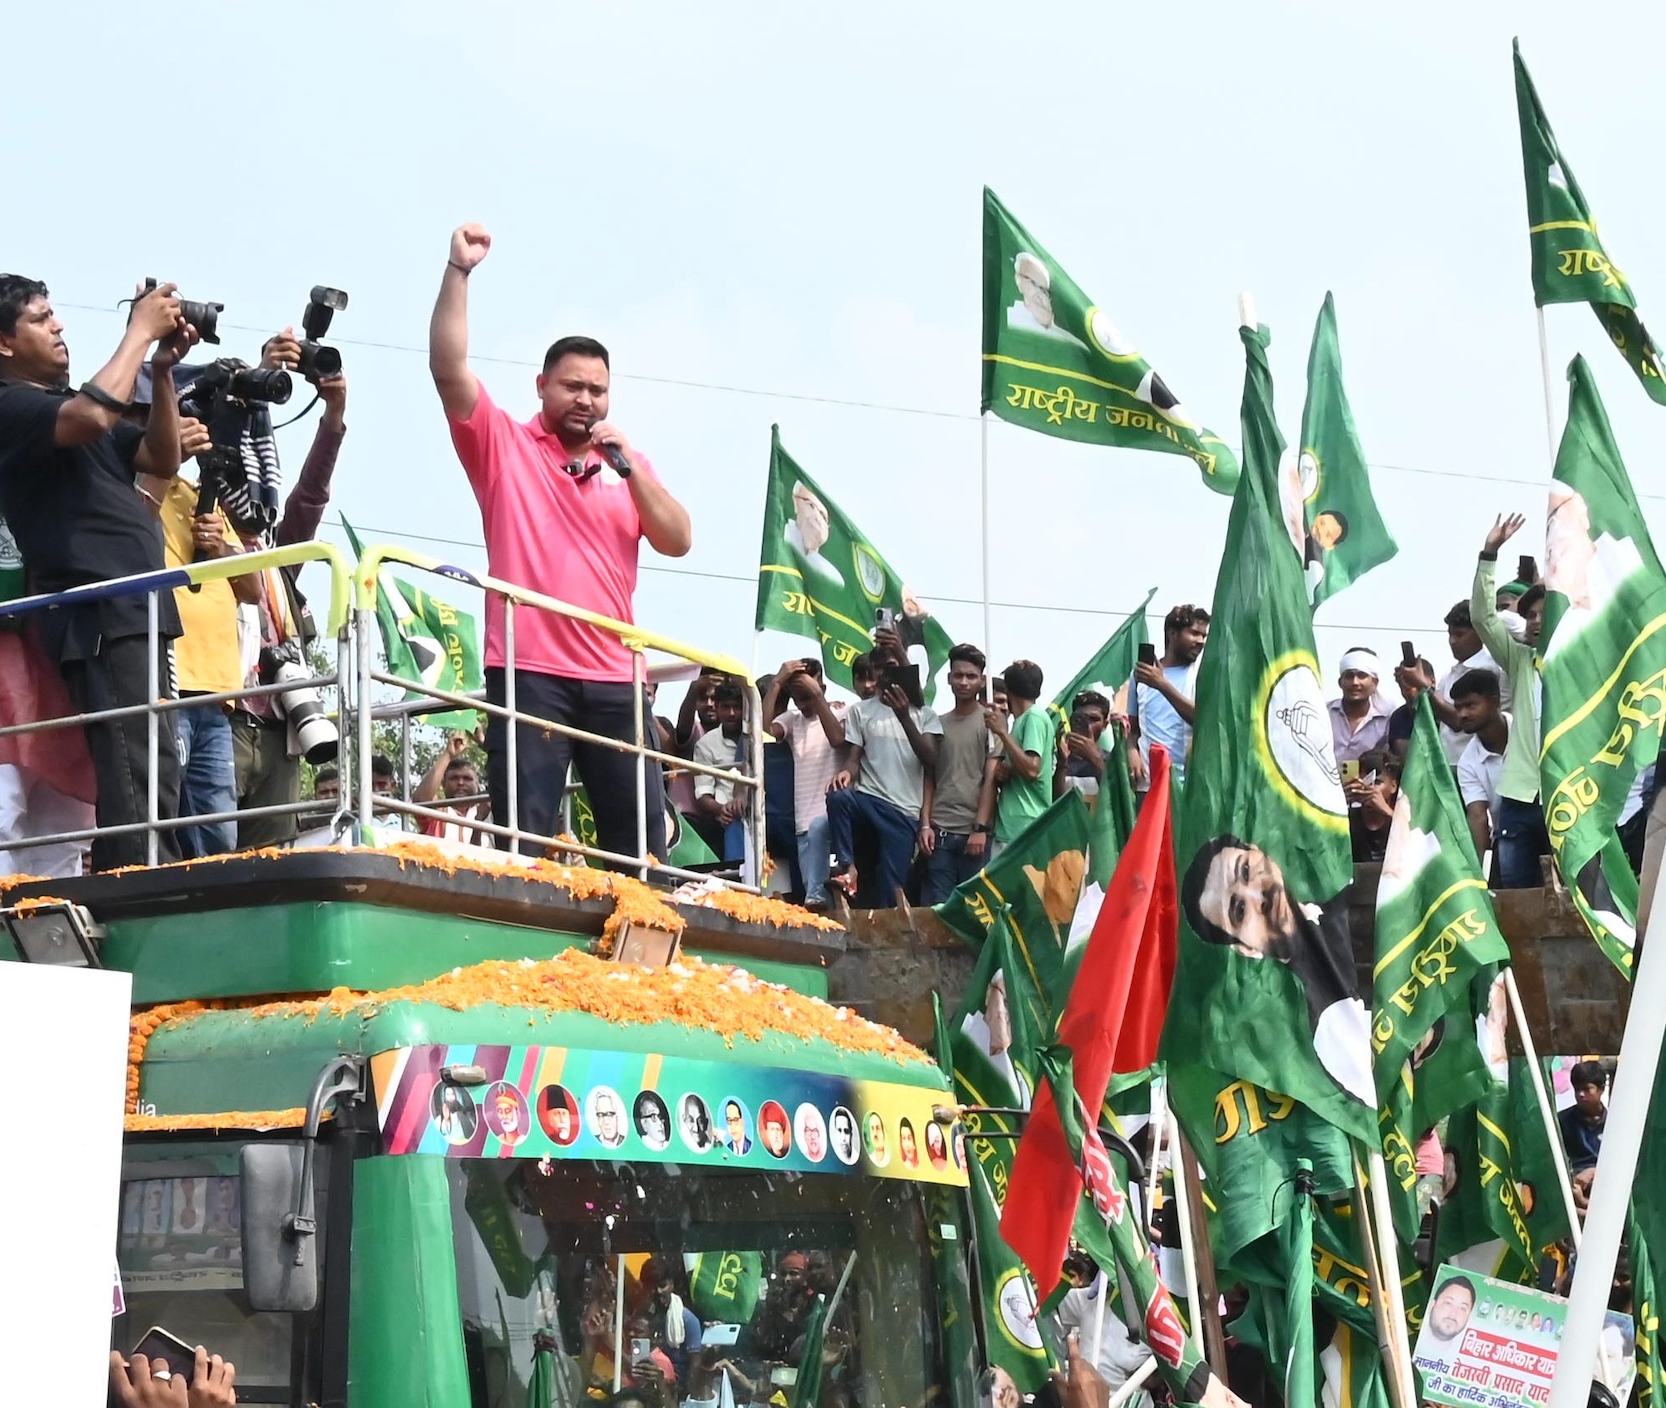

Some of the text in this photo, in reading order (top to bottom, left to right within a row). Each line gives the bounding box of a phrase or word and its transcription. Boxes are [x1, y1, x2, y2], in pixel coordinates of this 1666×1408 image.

[1006, 383, 1100, 426] राष्ट्रीय
[1462, 1330, 1493, 1364] बिहार
[1491, 1341, 1538, 1371] अधिकार
[1414, 1355, 1450, 1376] माननीय
[1493, 1373, 1524, 1397] प्रसाद
[1428, 1377, 1441, 1392] जी
[1442, 1385, 1456, 1397] का
[1456, 1386, 1487, 1405] हार्दिक
